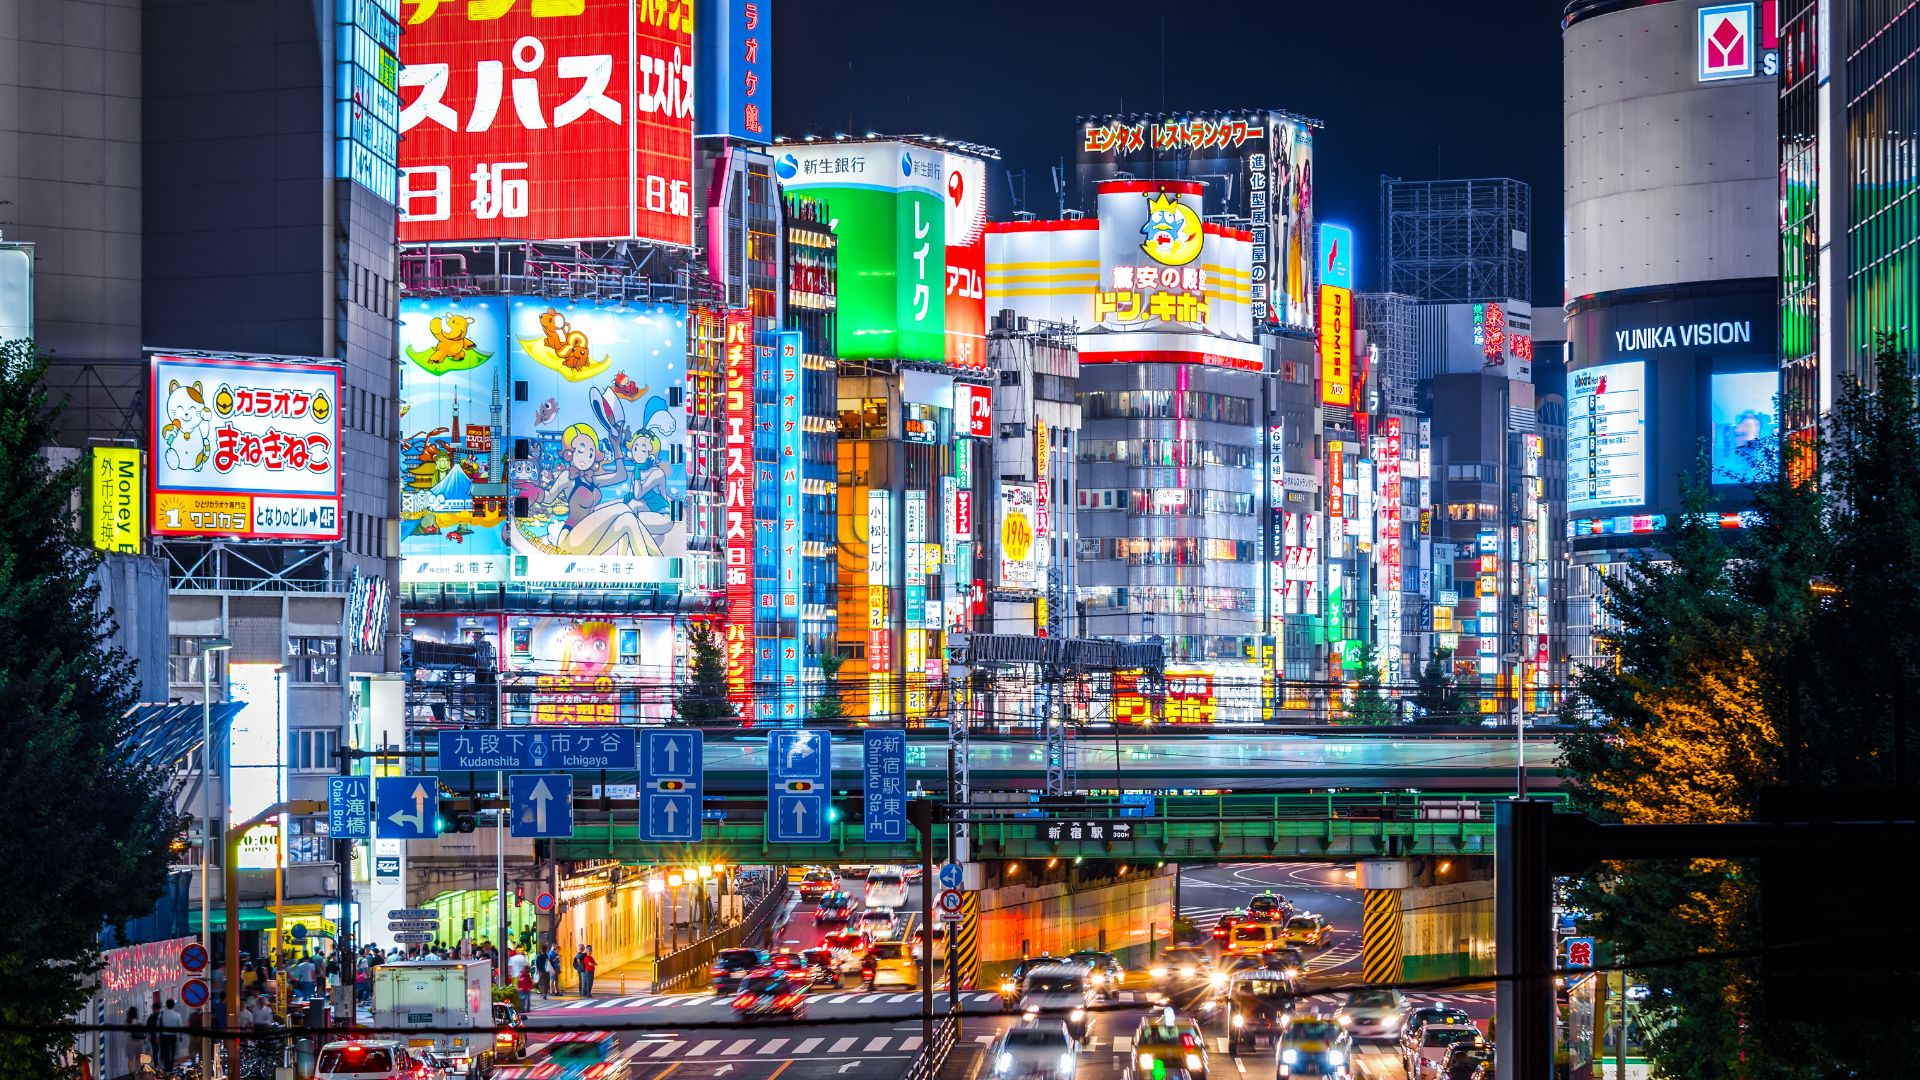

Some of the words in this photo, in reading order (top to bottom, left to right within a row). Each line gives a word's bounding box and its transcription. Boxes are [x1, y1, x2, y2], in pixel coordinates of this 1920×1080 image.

[639, 46, 694, 119] エスパス
[1085, 125, 1143, 152] エンタメ
[1151, 120, 1264, 150] レストランタワー
[803, 157, 866, 175] 新生銀行
[914, 159, 940, 181] 新生銀行
[1250, 153, 1266, 319] 進化型居酒屋の聖地
[913, 201, 930, 321] レイク
[946, 265, 983, 299] アコム
[1333, 294, 1341, 376] PROMISE
[1616, 327, 1677, 351] YUNIKA
[1680, 321, 1751, 347] VISION
[727, 322, 745, 410] パチンコ
[236, 390, 311, 417] カラオケ
[214, 423, 331, 473] まねきねこ
[727, 418, 745, 538] エスパス
[118, 460, 134, 534] Money
[190, 512, 246, 529] ワンカラ
[256, 506, 308, 528] となりのビル
[319, 507, 335, 529] 4F
[959, 502, 968, 532] アイフル
[870, 506, 882, 572] 小松ビル
[454, 562, 494, 574] 北電子
[599, 562, 634, 575] 北電子
[727, 548, 746, 585] 日拓
[454, 734, 525, 755] 九段下
[534, 745, 542, 756] 4
[460, 756, 520, 767] Kudanshita
[563, 755, 608, 768] Ichigaya
[867, 739, 882, 788] Shinjuku
[333, 780, 344, 806] Otaki
[882, 736, 901, 835] 新宿駅東口
[332, 809, 344, 835] Brdg.
[346, 780, 366, 835] 小滝橋
[1049, 826, 1103, 839] 新宿駅
[1570, 942, 1591, 964] 祭
